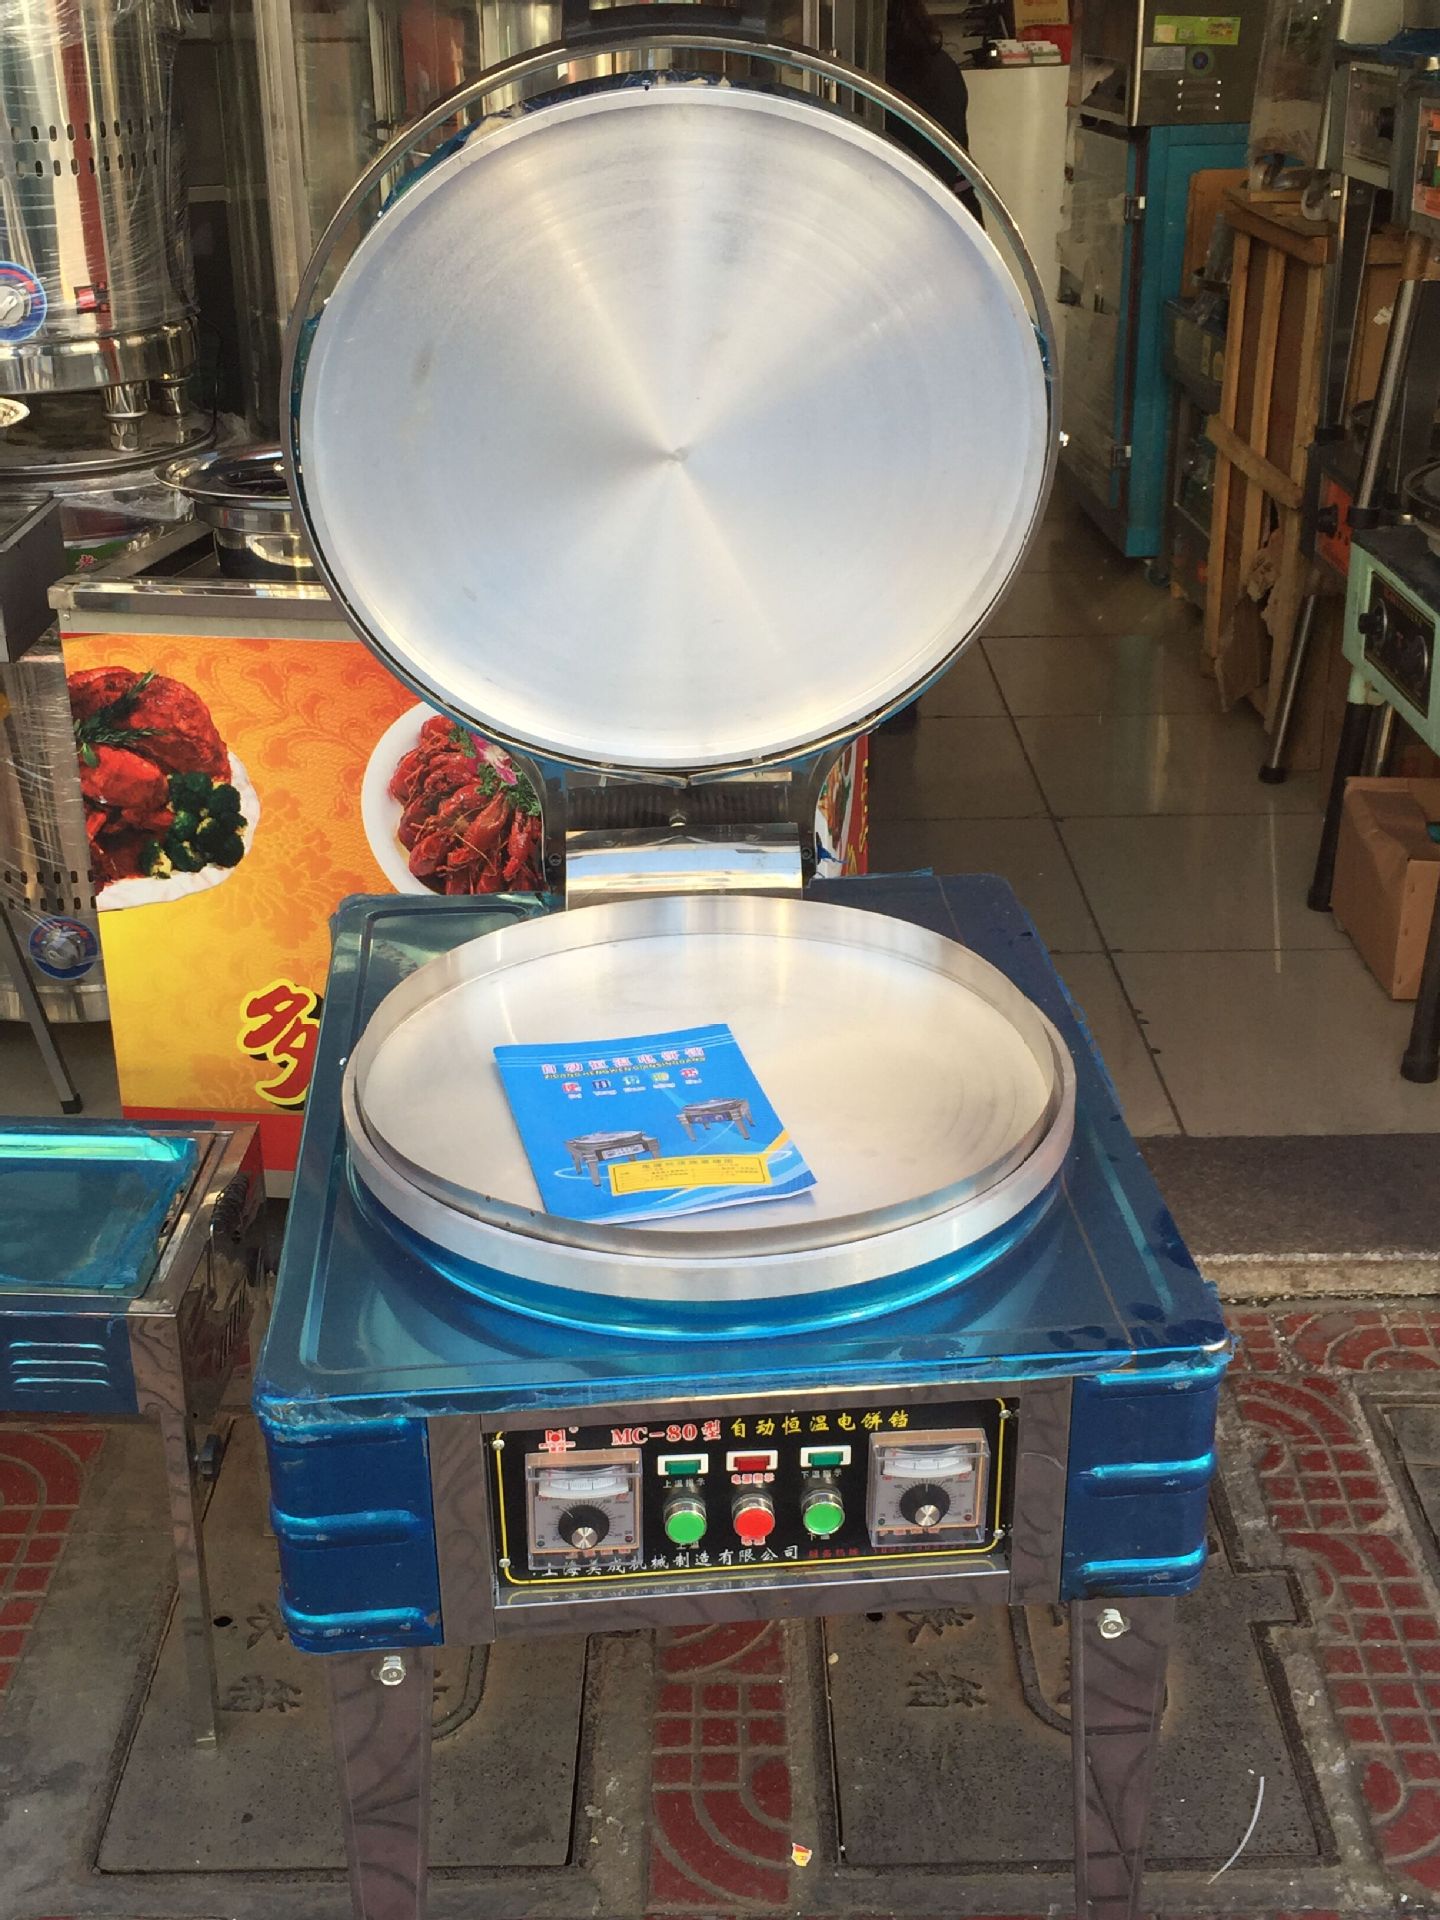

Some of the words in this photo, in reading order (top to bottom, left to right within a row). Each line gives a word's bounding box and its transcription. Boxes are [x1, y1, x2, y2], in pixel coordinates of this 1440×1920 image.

[611, 1420, 721, 1446] MC-80型
[731, 1409, 909, 1438] 自动恒温电饼铛
